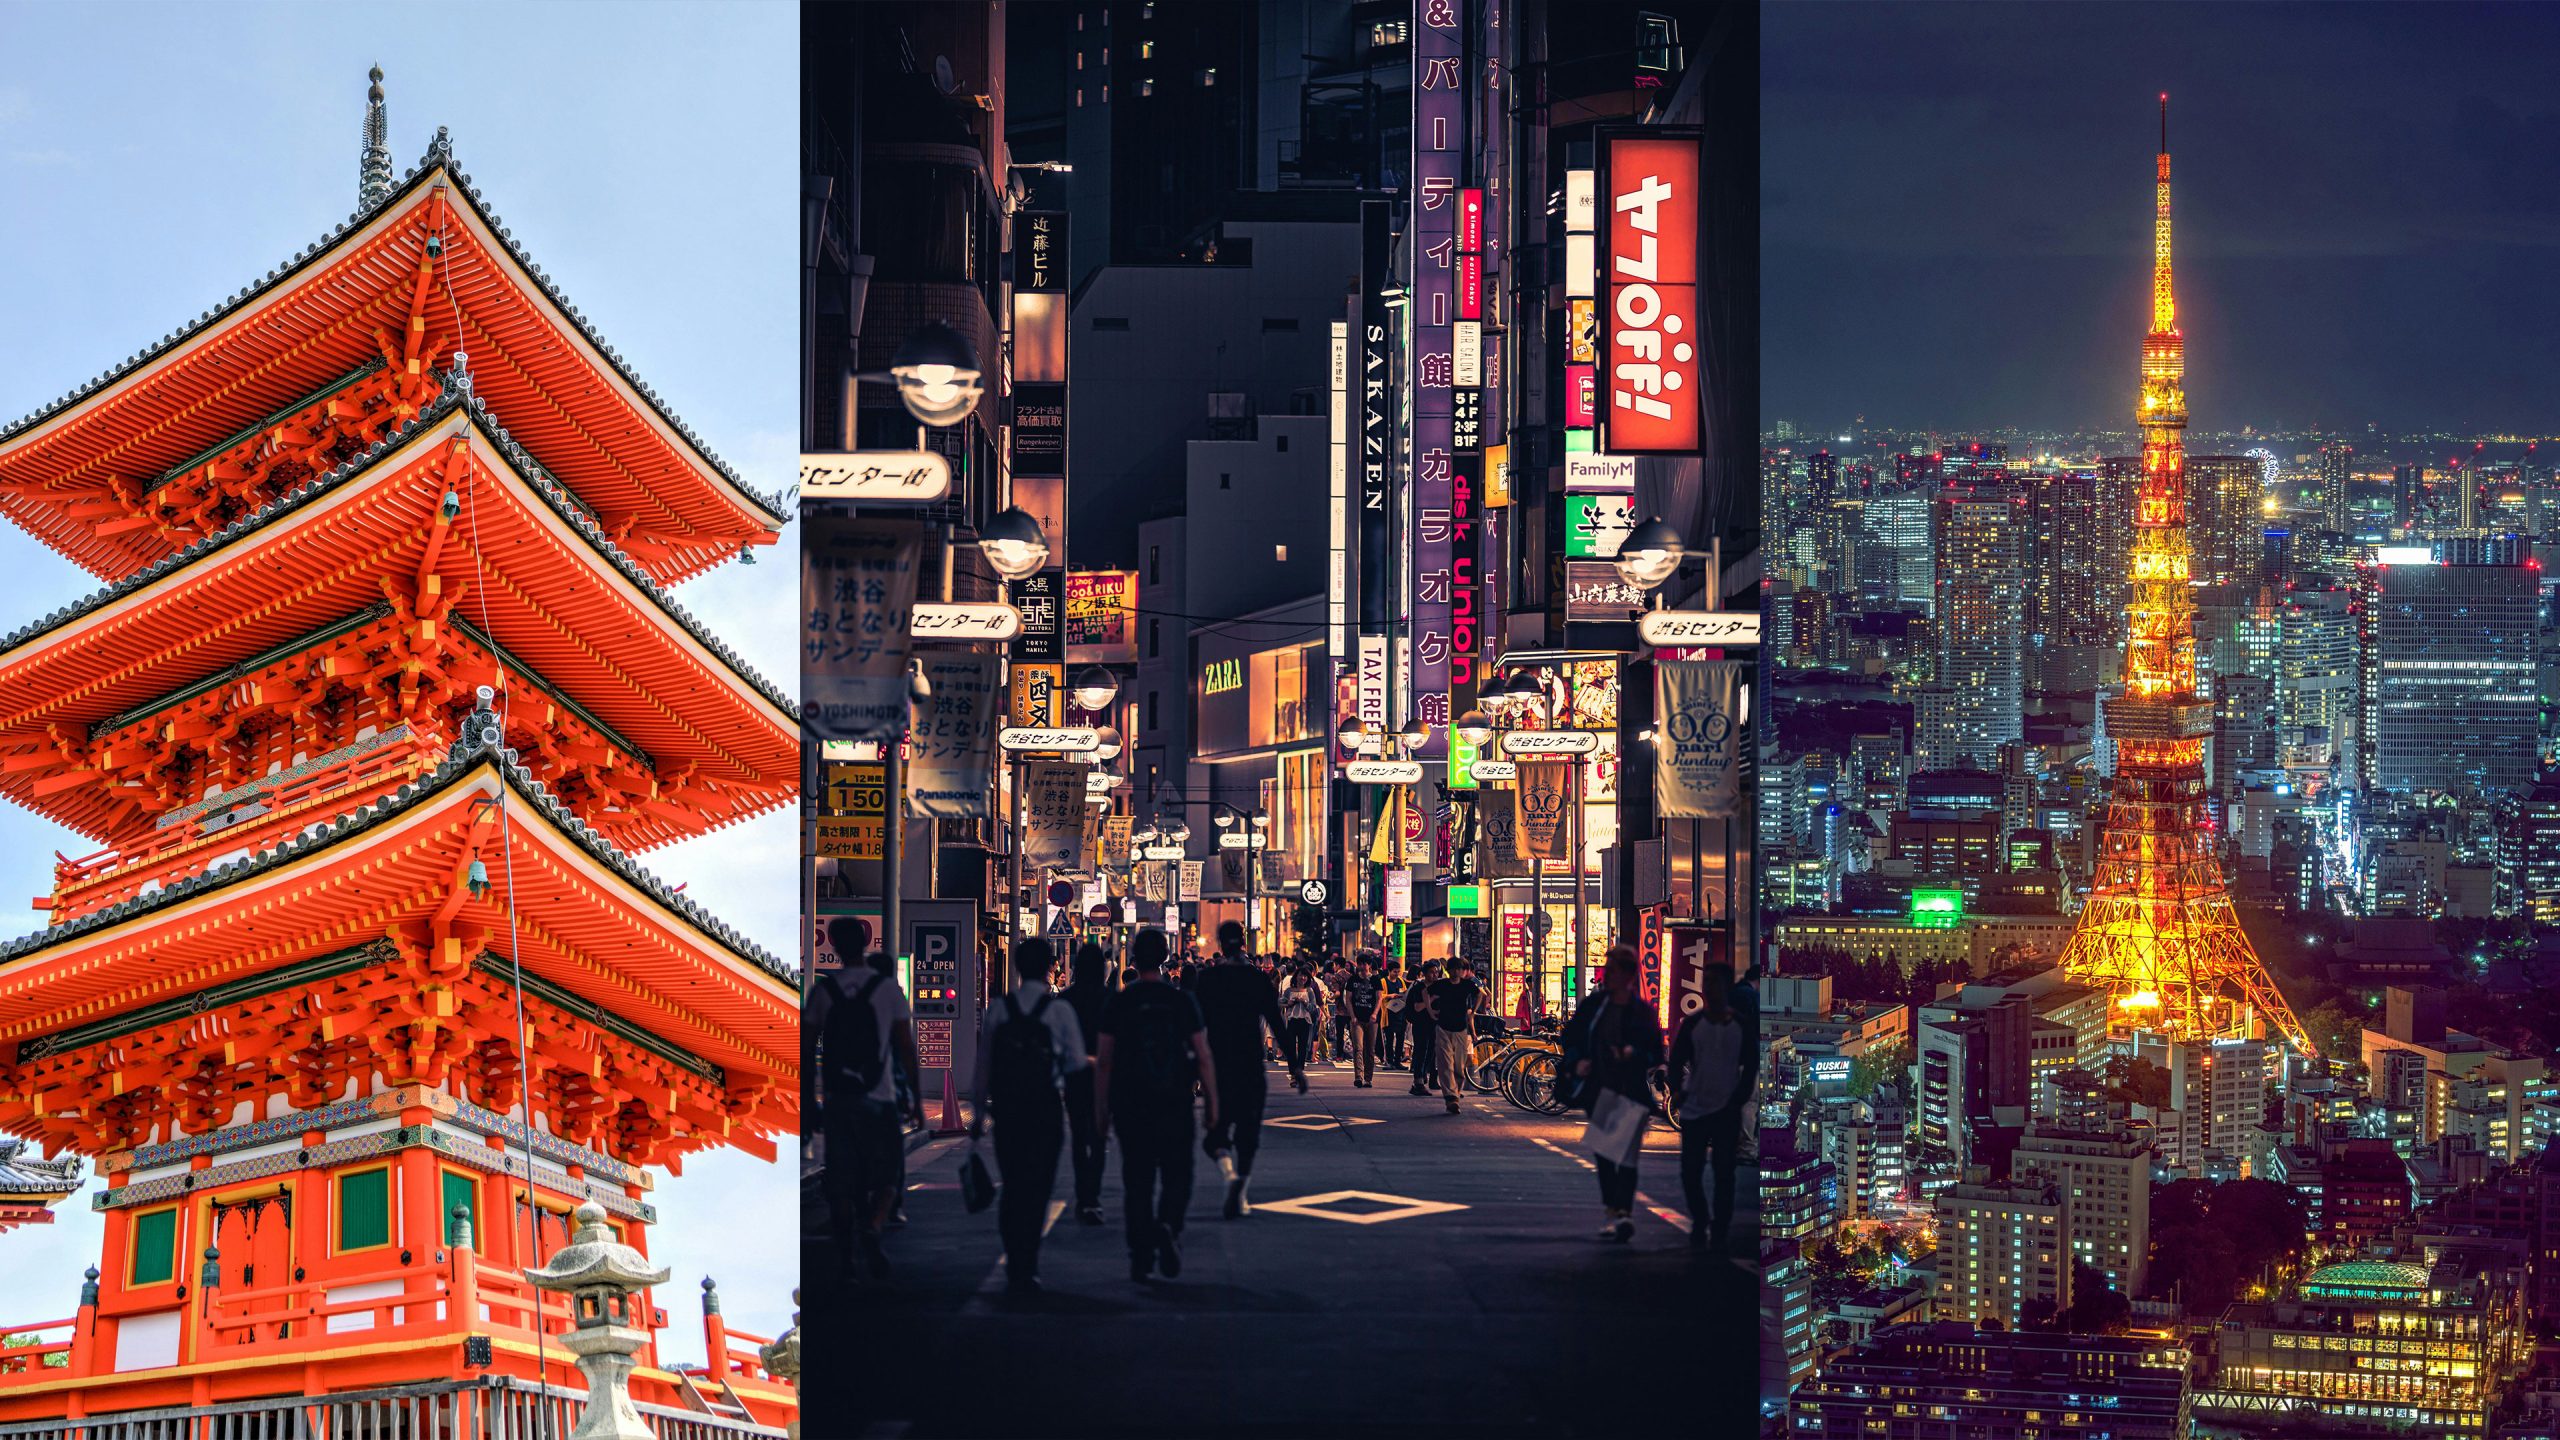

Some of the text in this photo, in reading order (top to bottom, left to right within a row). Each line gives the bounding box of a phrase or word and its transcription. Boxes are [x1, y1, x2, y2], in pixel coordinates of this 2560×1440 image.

[1469, 215, 1477, 244] kimono
[1033, 217, 1051, 288] 近藤ビル
[1461, 325, 1474, 343] HAIR
[1460, 347, 1473, 372] SALON
[1017, 406, 1062, 414] ブランド古着
[1017, 415, 1062, 427] 高価買取
[1366, 325, 1384, 511] SAKAZEN
[1455, 435, 1478, 446] B1F
[800, 466, 933, 487] センター街
[1453, 475, 1477, 685] disk union
[808, 608, 907, 634] おとなり
[912, 614, 1008, 630] センター街
[1652, 621, 1760, 636] 渋谷センター
[1067, 633, 1085, 644] AFE
[806, 640, 905, 662] サンデー
[1205, 658, 1243, 695] ZARA
[1364, 648, 1382, 732] TAX FREE
[916, 719, 988, 738] おとなり
[1006, 733, 1093, 745] 渋谷センター街
[1508, 736, 1591, 747] 渋谷センター街
[915, 742, 989, 760] サンデー
[855, 774, 885, 783] 12時間
[916, 788, 980, 801] Panasonic
[1044, 790, 1070, 801] 渋谷
[1031, 805, 1080, 816] おとなり
[1030, 820, 1080, 831] サンデー
[1520, 819, 1564, 830] Sunday
[820, 826, 859, 838] 高さ制限
[867, 843, 885, 855] 1.8
[926, 935, 948, 962] P
[933, 961, 955, 970] OPEN
[1815, 1060, 1849, 1071] DUSKIN
